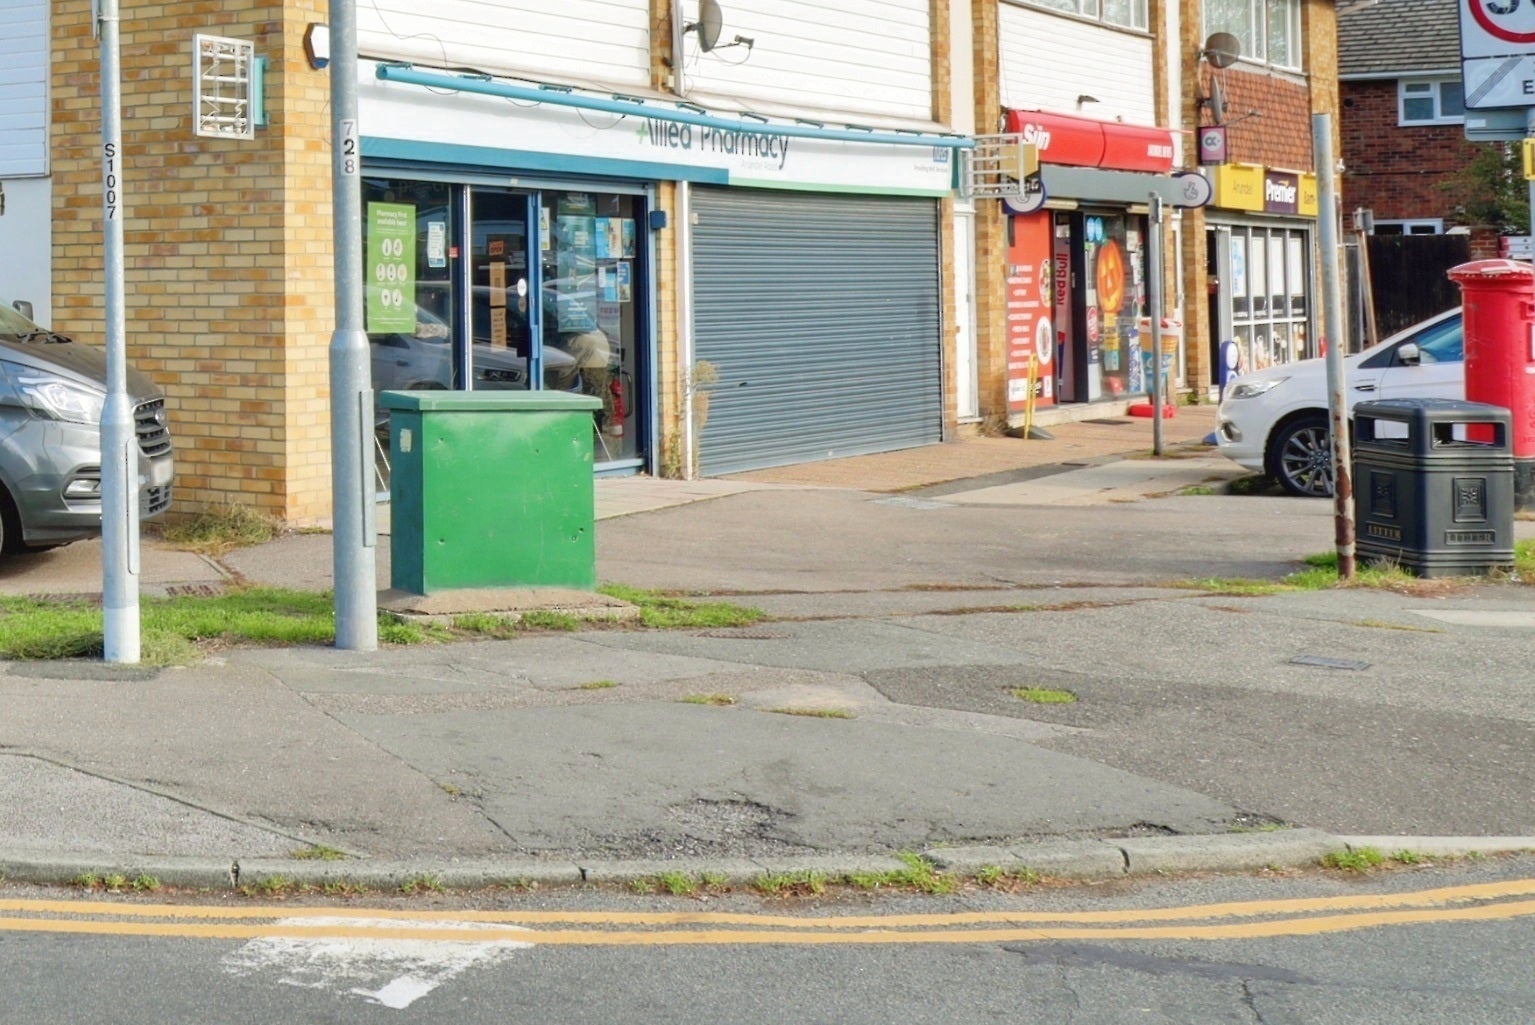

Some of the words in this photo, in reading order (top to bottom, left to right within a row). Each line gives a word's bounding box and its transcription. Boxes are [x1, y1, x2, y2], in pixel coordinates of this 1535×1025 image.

[343, 121, 355, 175] 728
[104, 142, 116, 220] S1007
[1266, 178, 1296, 204] Premier
[1056, 253, 1068, 278] Bull
